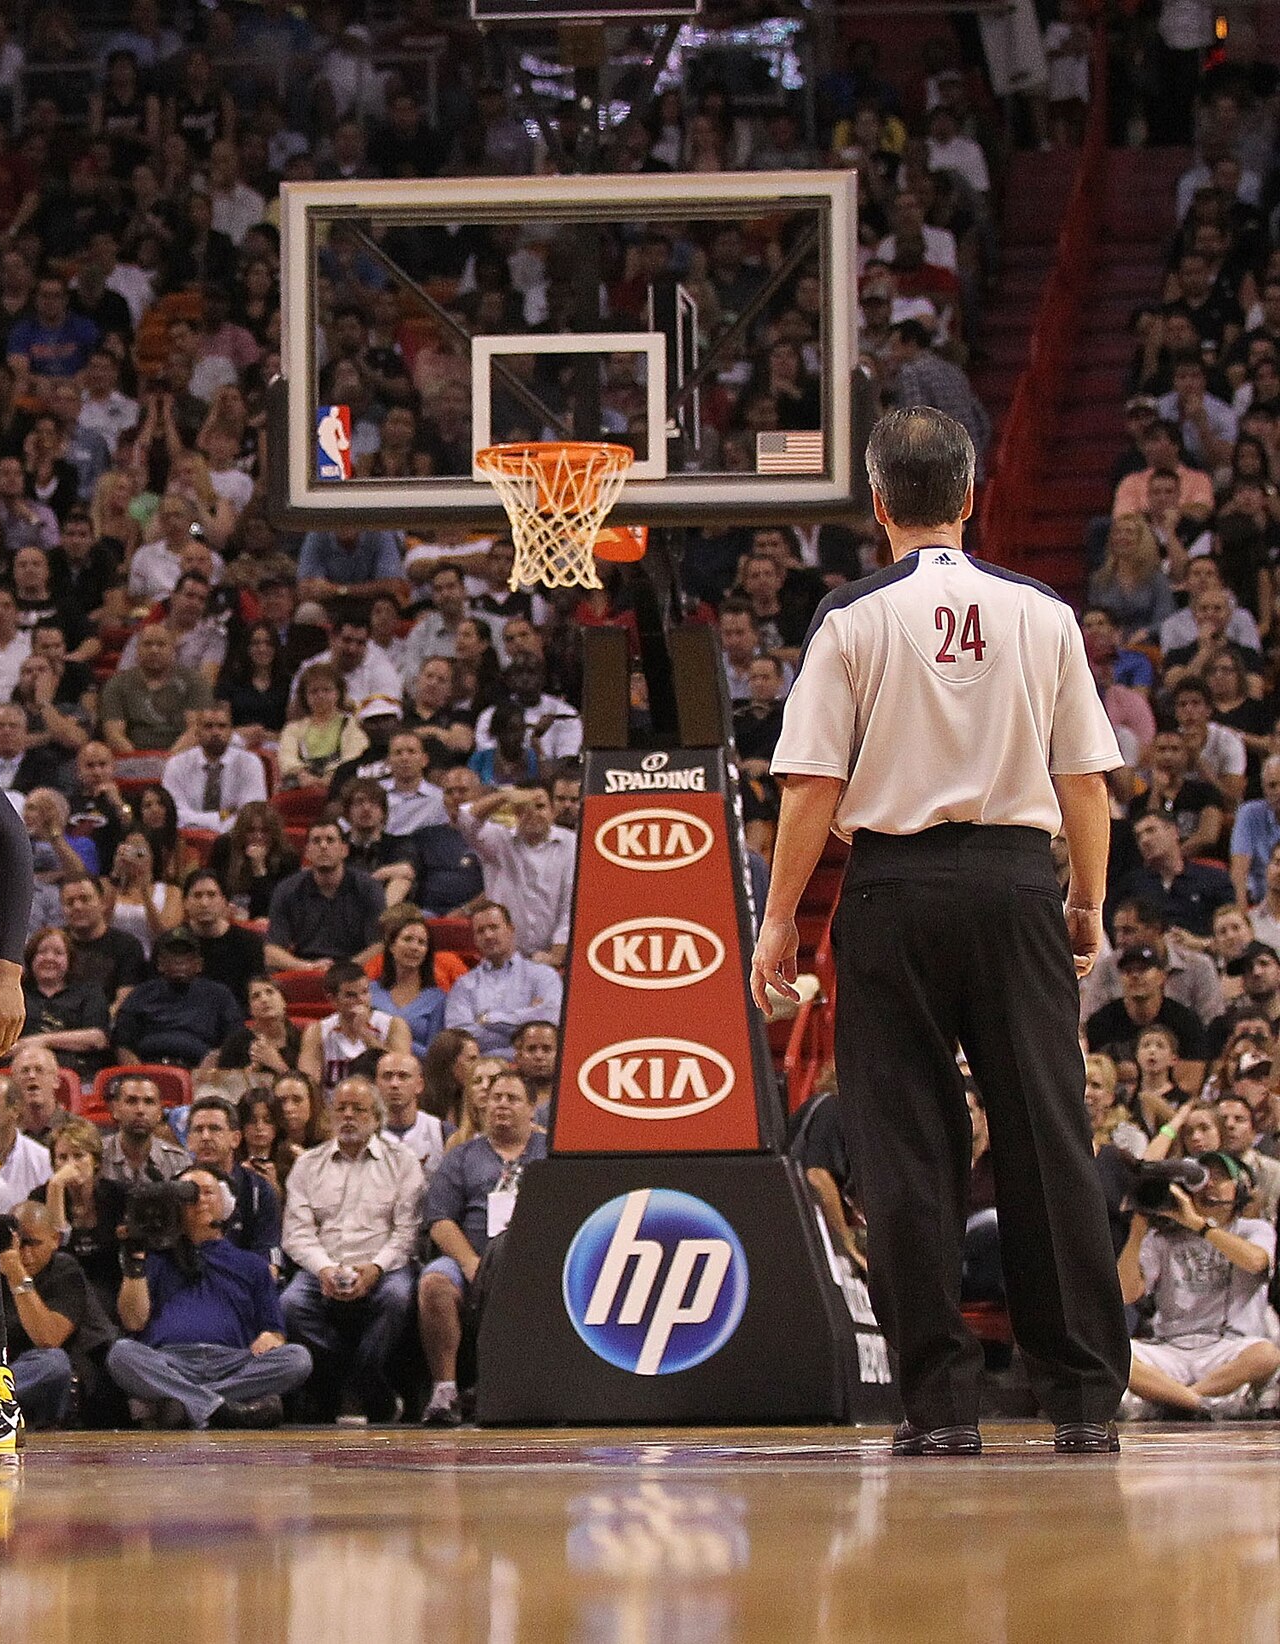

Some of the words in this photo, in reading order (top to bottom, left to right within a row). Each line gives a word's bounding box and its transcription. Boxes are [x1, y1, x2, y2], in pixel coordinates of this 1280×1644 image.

[934, 603, 987, 663] 24
[605, 767, 706, 793] SPALDING
[617, 823, 695, 857] KIA
[611, 934, 703, 973] KIA
[606, 1057, 710, 1100] KIA
[583, 1188, 732, 1376] hp
